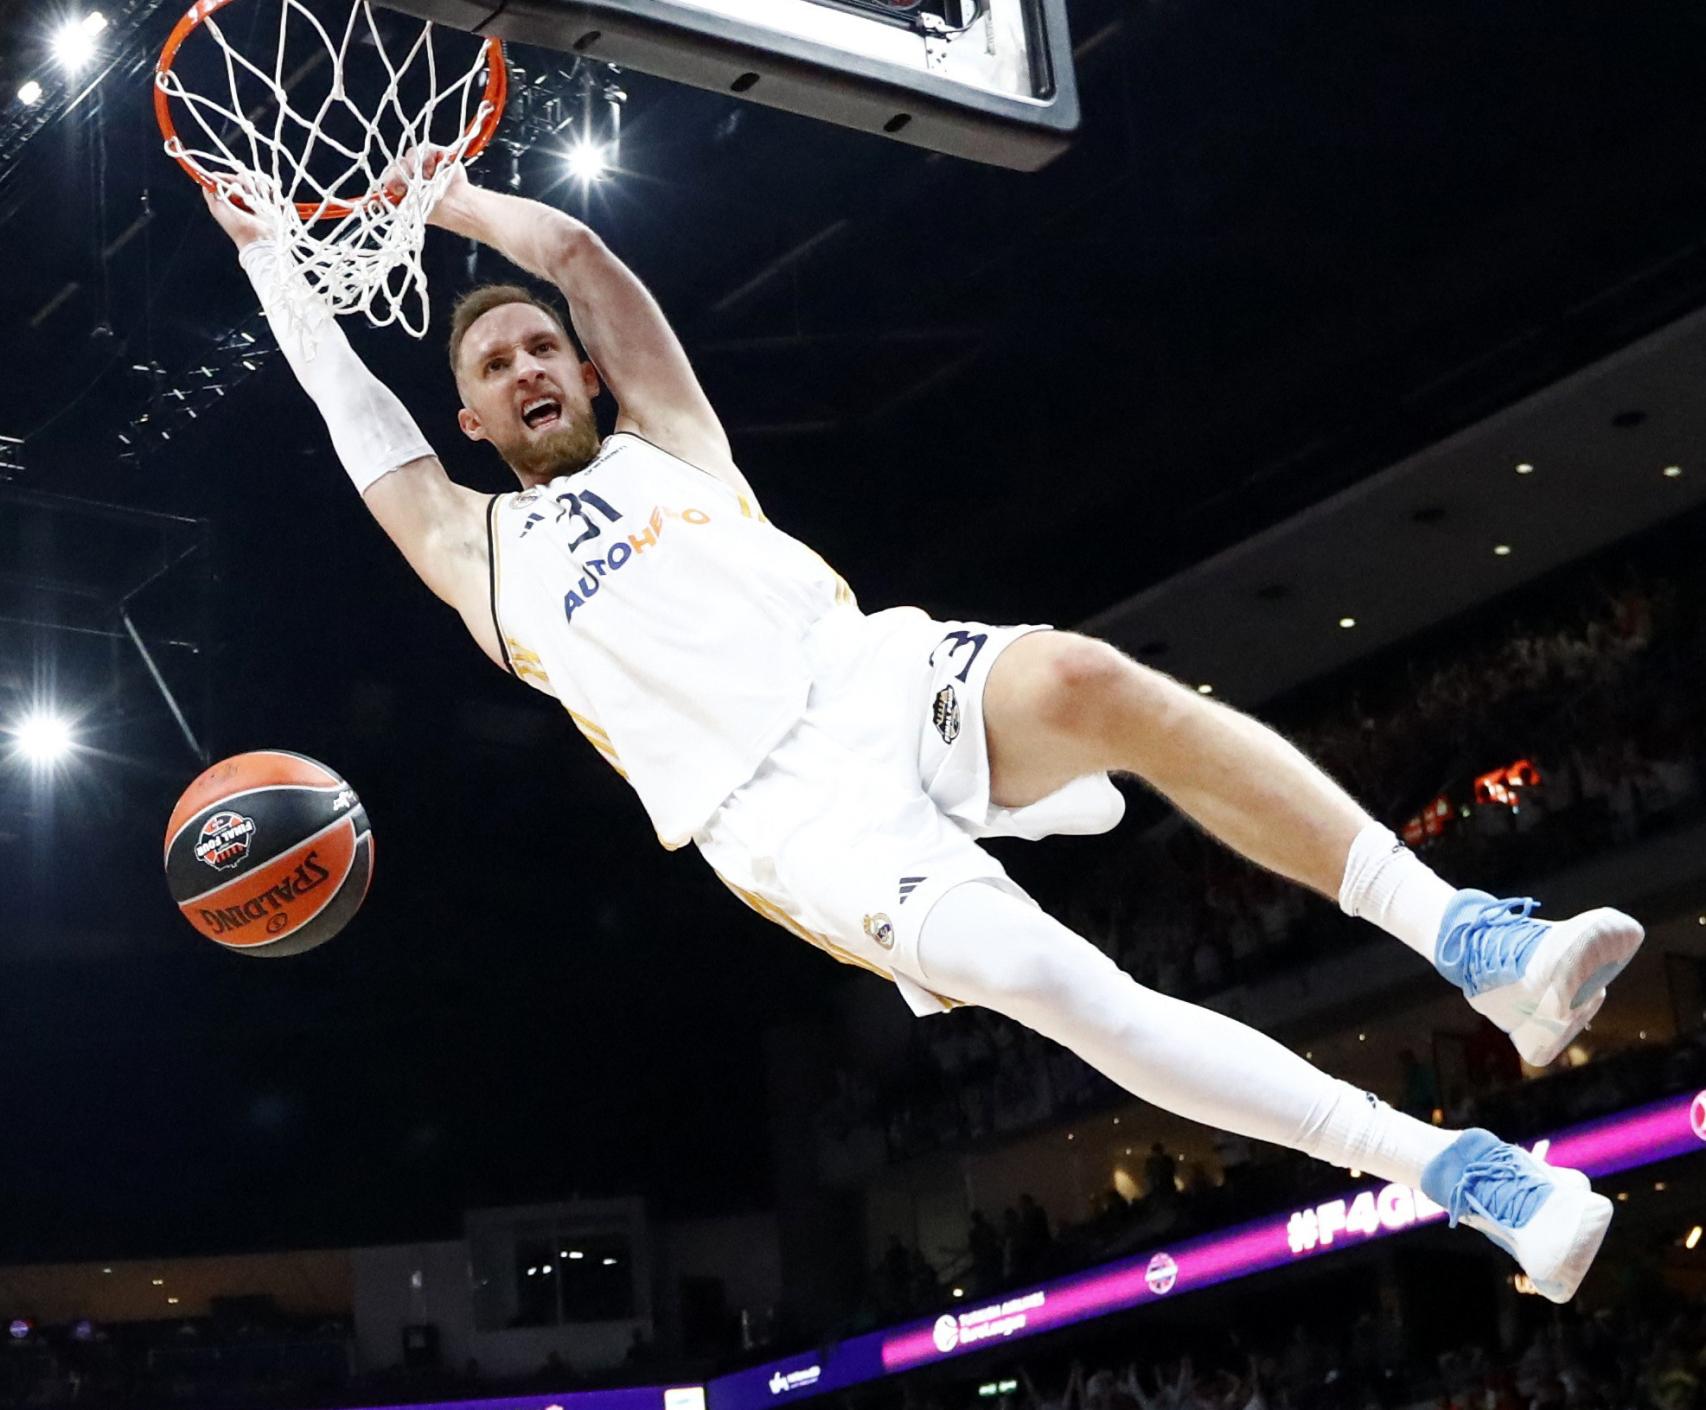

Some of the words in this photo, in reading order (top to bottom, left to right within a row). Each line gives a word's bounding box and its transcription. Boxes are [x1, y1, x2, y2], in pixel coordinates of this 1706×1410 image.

[555, 489, 623, 553] 31
[196, 835, 223, 857] FOUR
[221, 820, 253, 842] FINAL
[198, 850, 330, 935] SPALDING
